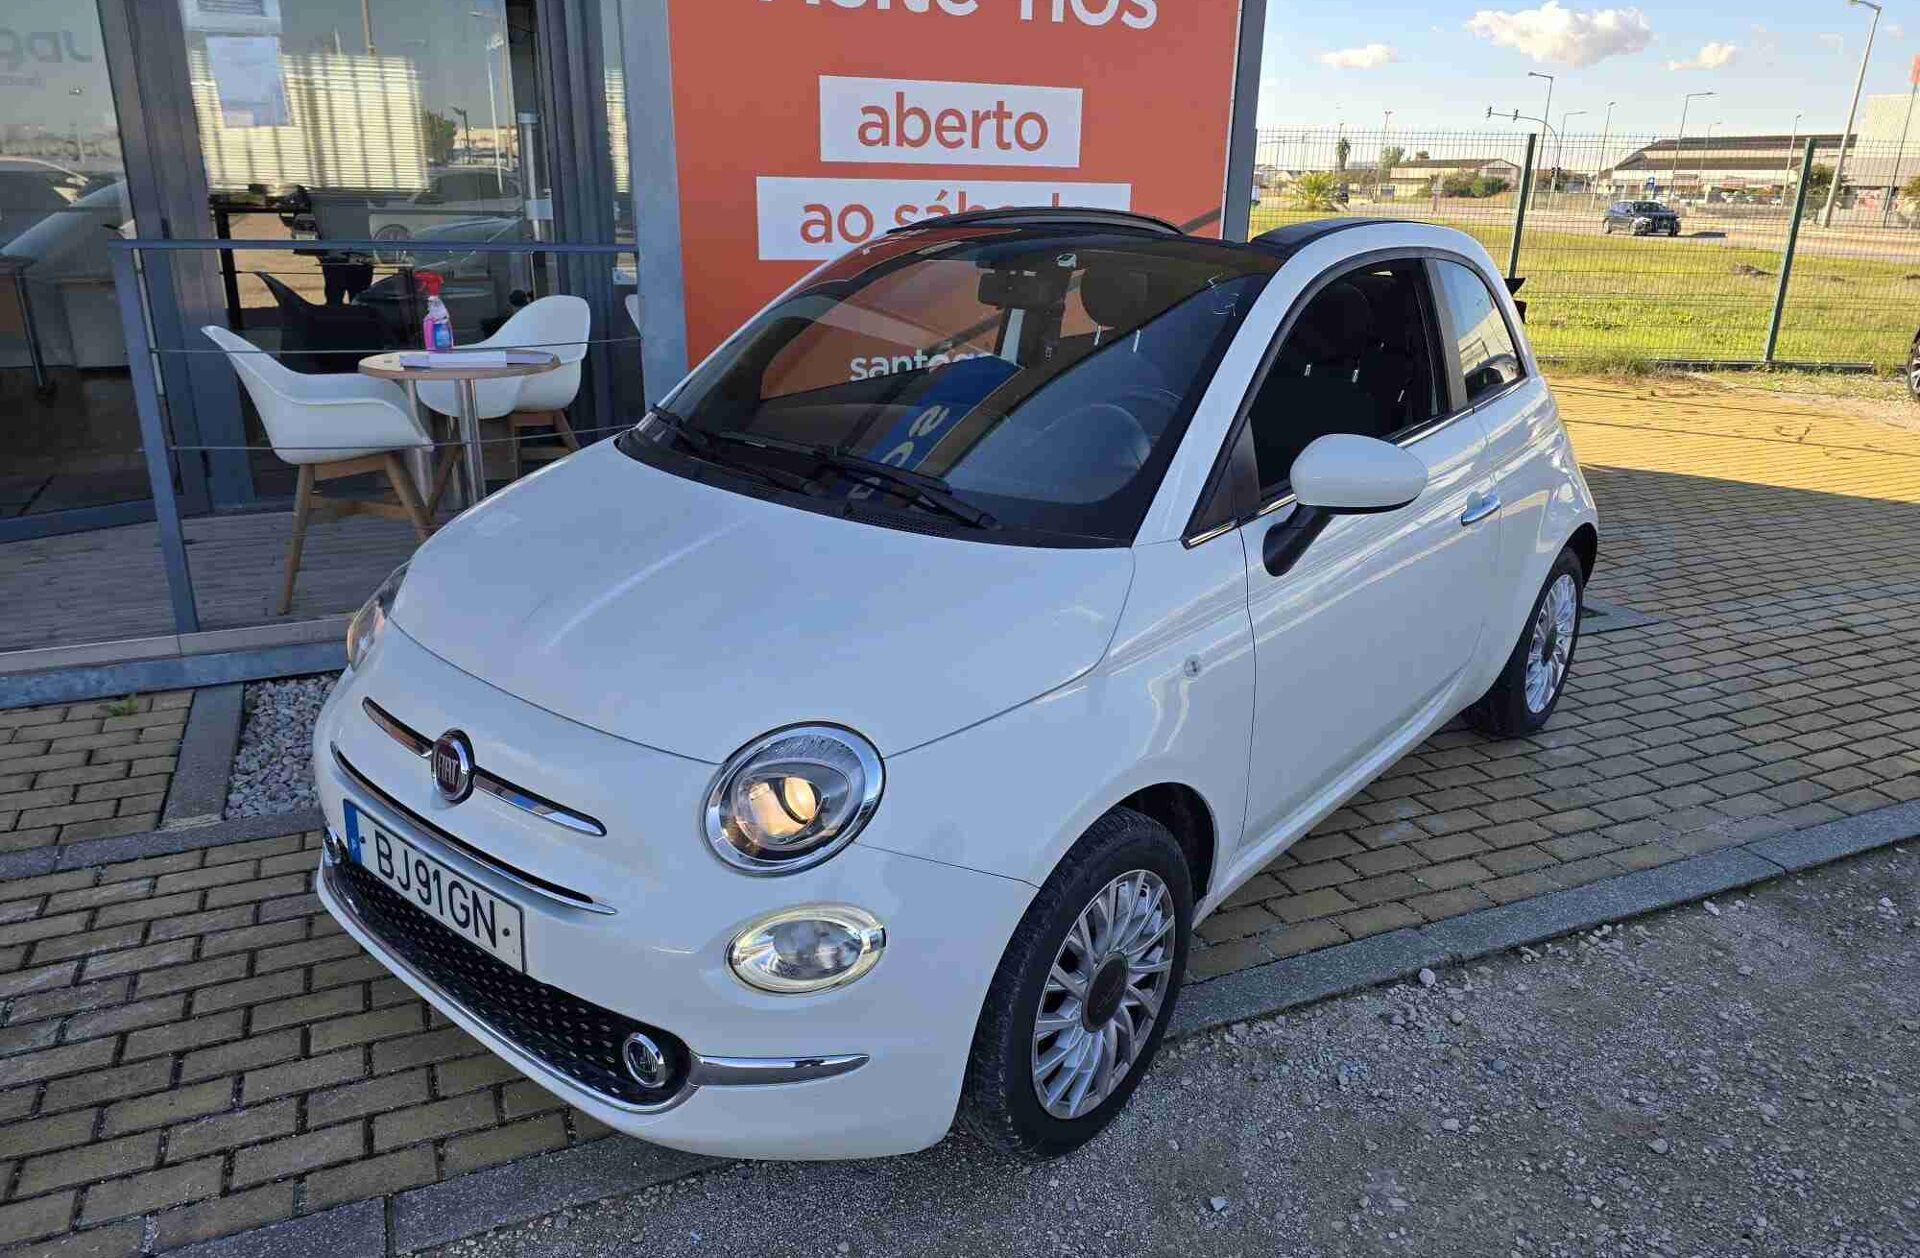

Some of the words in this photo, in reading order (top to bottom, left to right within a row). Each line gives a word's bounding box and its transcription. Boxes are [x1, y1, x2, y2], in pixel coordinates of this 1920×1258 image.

[857, 92, 1048, 151] aberto
[800, 203, 874, 244] ao
[438, 753, 458, 784] FIAT
[374, 829, 498, 949] BJ91GN
